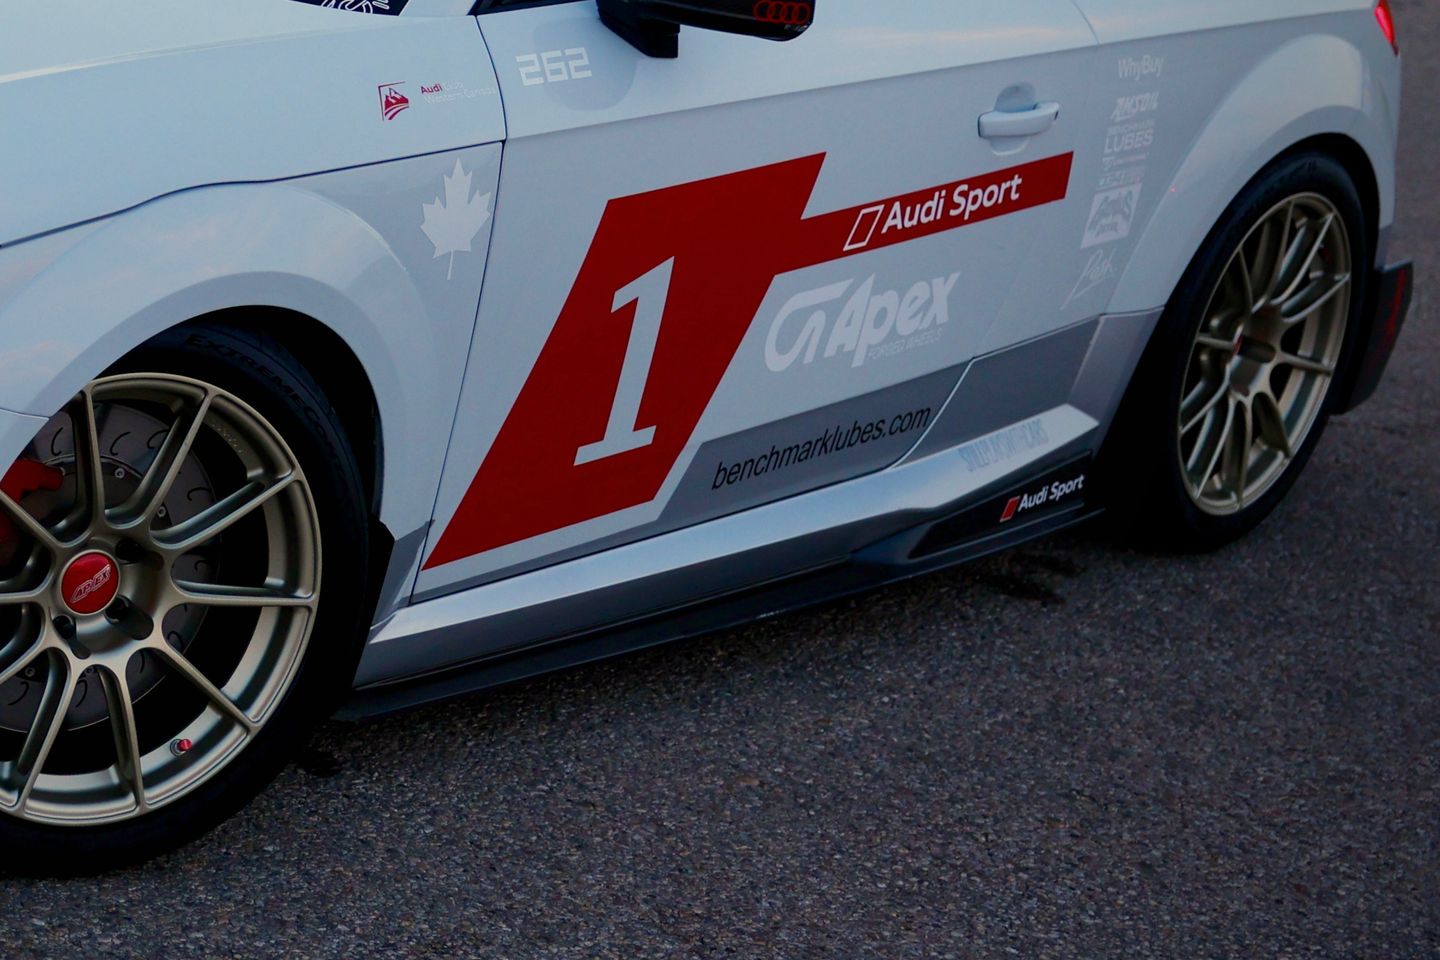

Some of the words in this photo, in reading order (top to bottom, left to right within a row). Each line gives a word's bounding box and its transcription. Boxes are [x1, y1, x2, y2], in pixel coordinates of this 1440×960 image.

[515, 47, 592, 87] 262
[420, 82, 443, 94] Audi
[1104, 128, 1153, 154] LUBES
[881, 192, 945, 236] Audi
[949, 172, 1023, 221] Sport
[573, 256, 675, 467] 1
[711, 403, 932, 490] benchmarklubes.com
[1018, 485, 1049, 513] Audi
[1050, 474, 1084, 507] Sport
